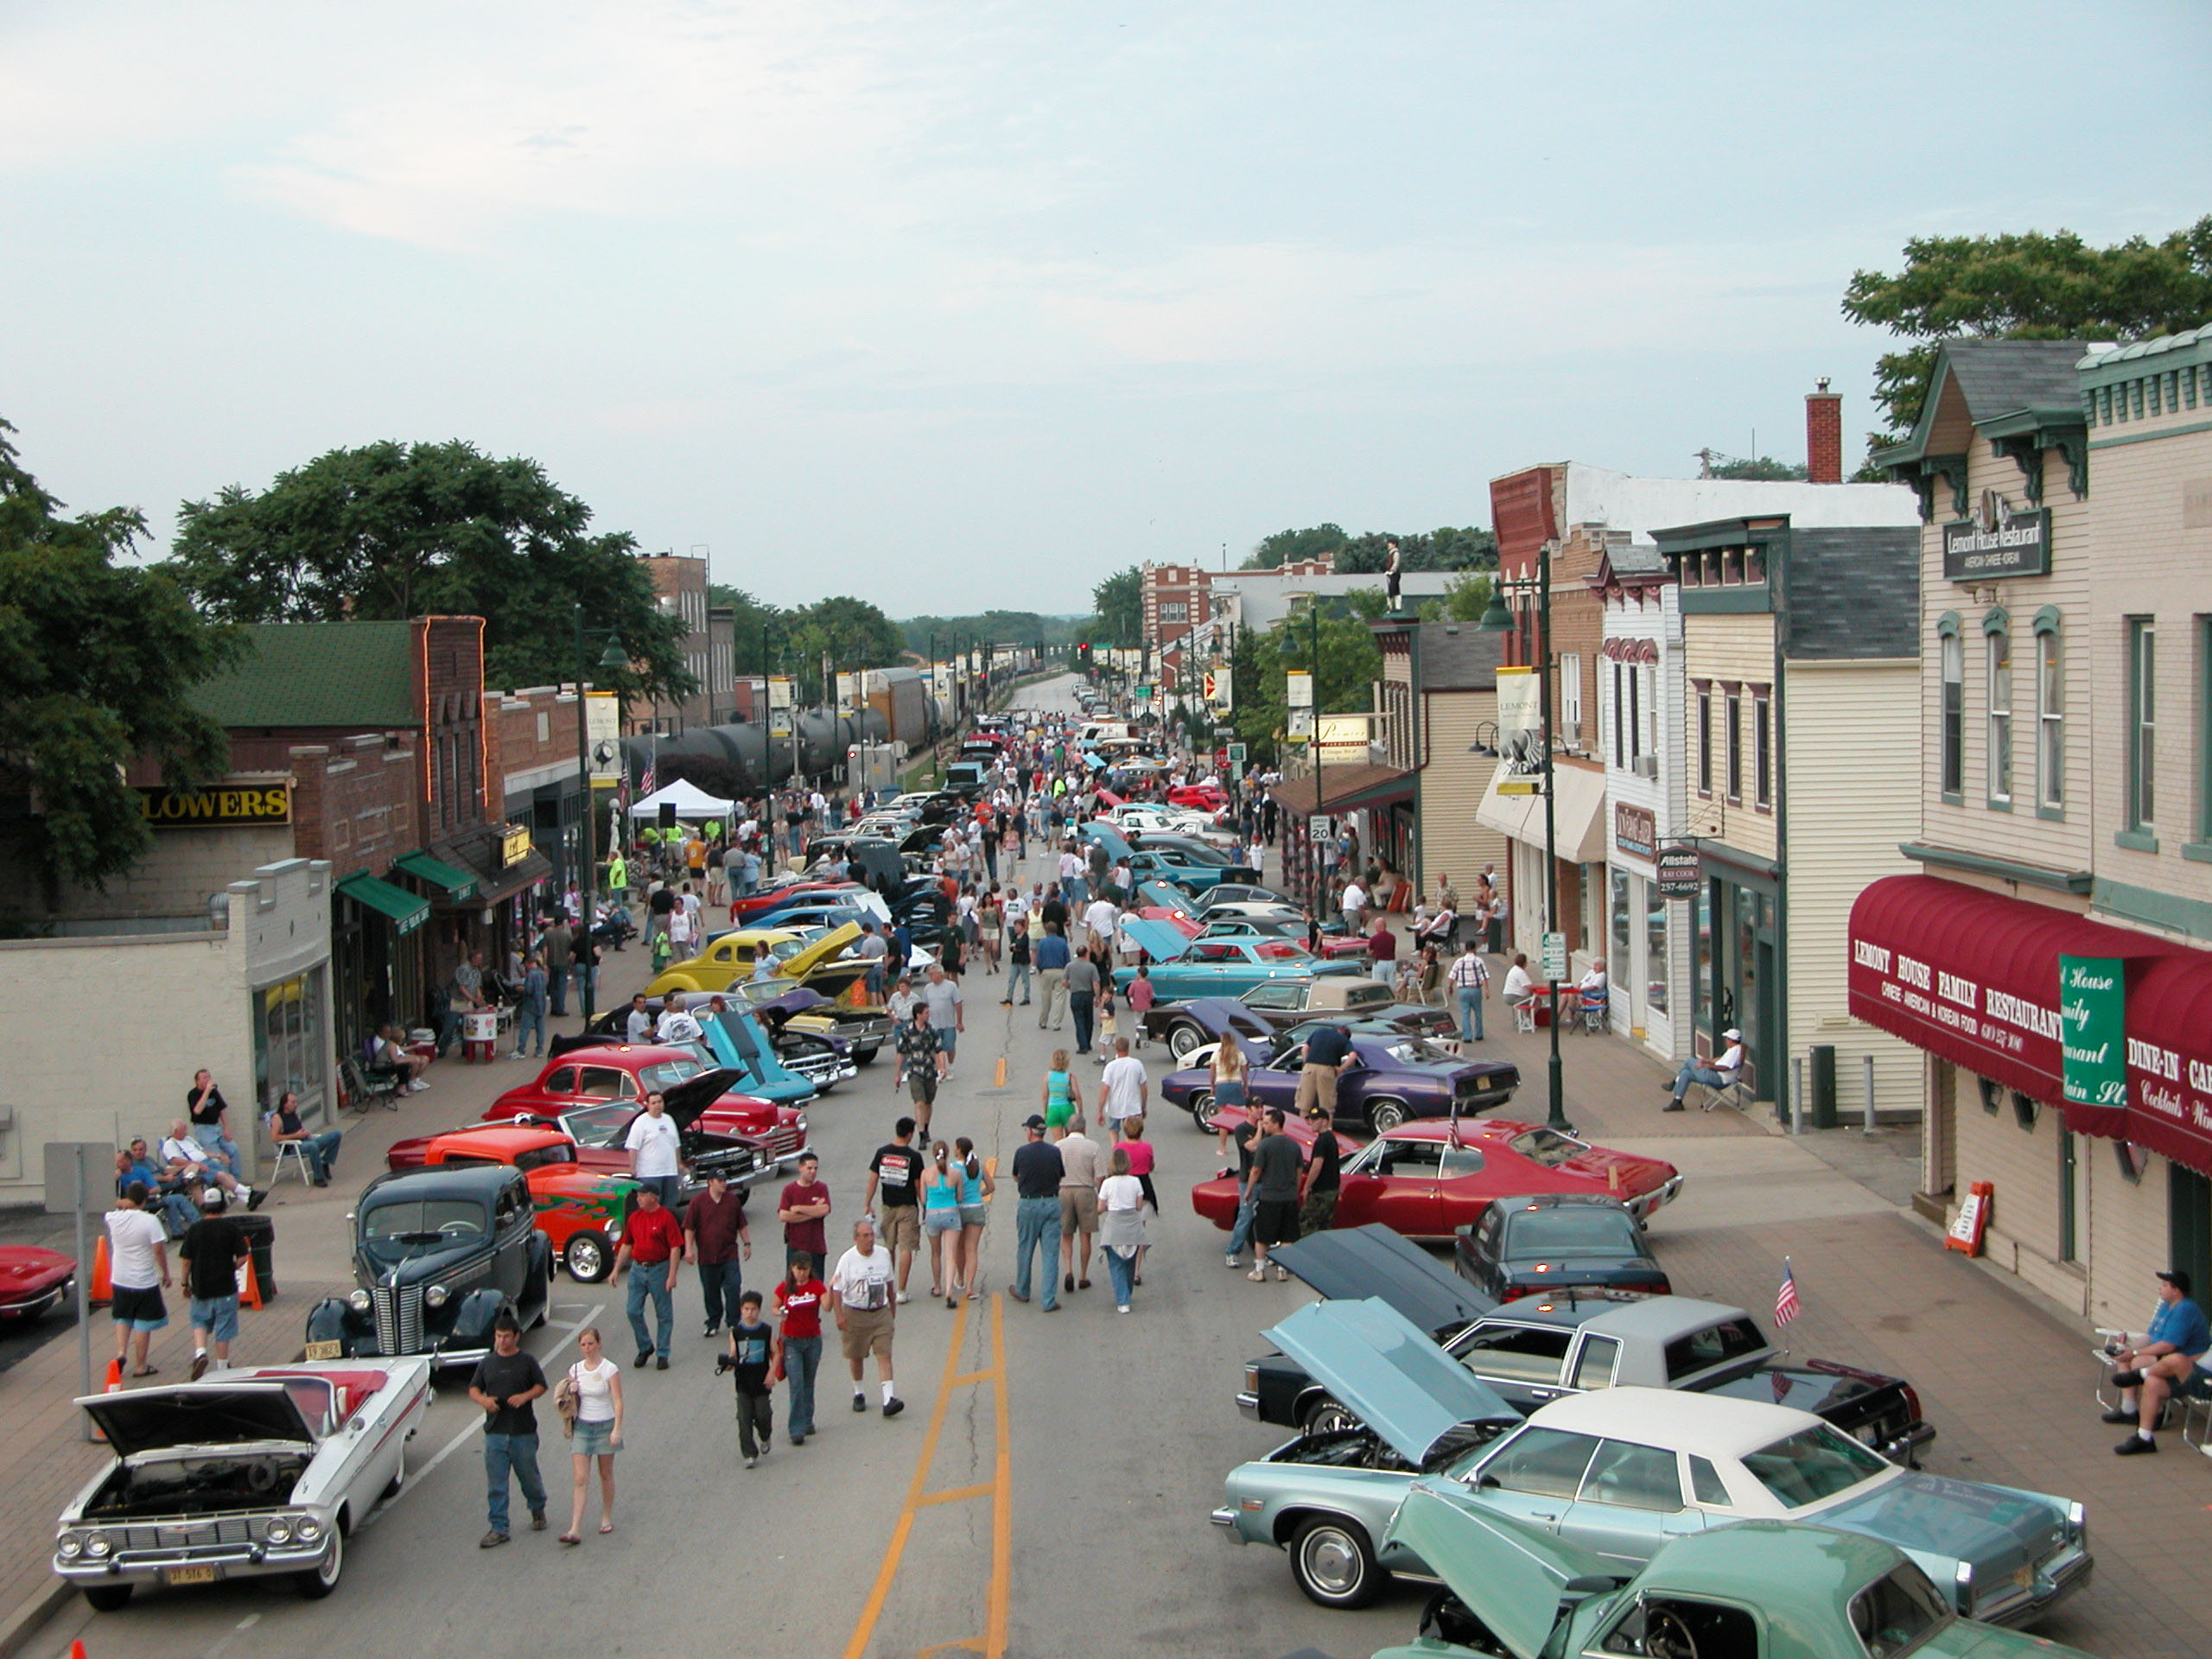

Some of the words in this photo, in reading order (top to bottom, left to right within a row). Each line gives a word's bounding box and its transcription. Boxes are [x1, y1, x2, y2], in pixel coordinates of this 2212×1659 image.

[1948, 531, 1975, 554] Lemont
[1976, 525, 1999, 550] House
[1999, 521, 2040, 548] Restaurant
[1500, 701, 1538, 711] LEMONT
[141, 790, 288, 819] LOWERS
[1313, 829, 1329, 839] 20
[1661, 855, 1699, 867] Allstate
[1661, 881, 1700, 892] 257-6692
[1854, 938, 1891, 975] LEMONT
[1897, 954, 1931, 991] HOUSE
[1938, 970, 1977, 1010] FAMILY
[1986, 988, 2064, 1043] RESTAURANT
[2069, 966, 2113, 990] House
[1961, 1013, 1978, 1036] FOOD
[2126, 1037, 2179, 1082] DINE-IN
[2095, 1080, 2128, 1107] St.
[2140, 1078, 2183, 1118] Cocktails
